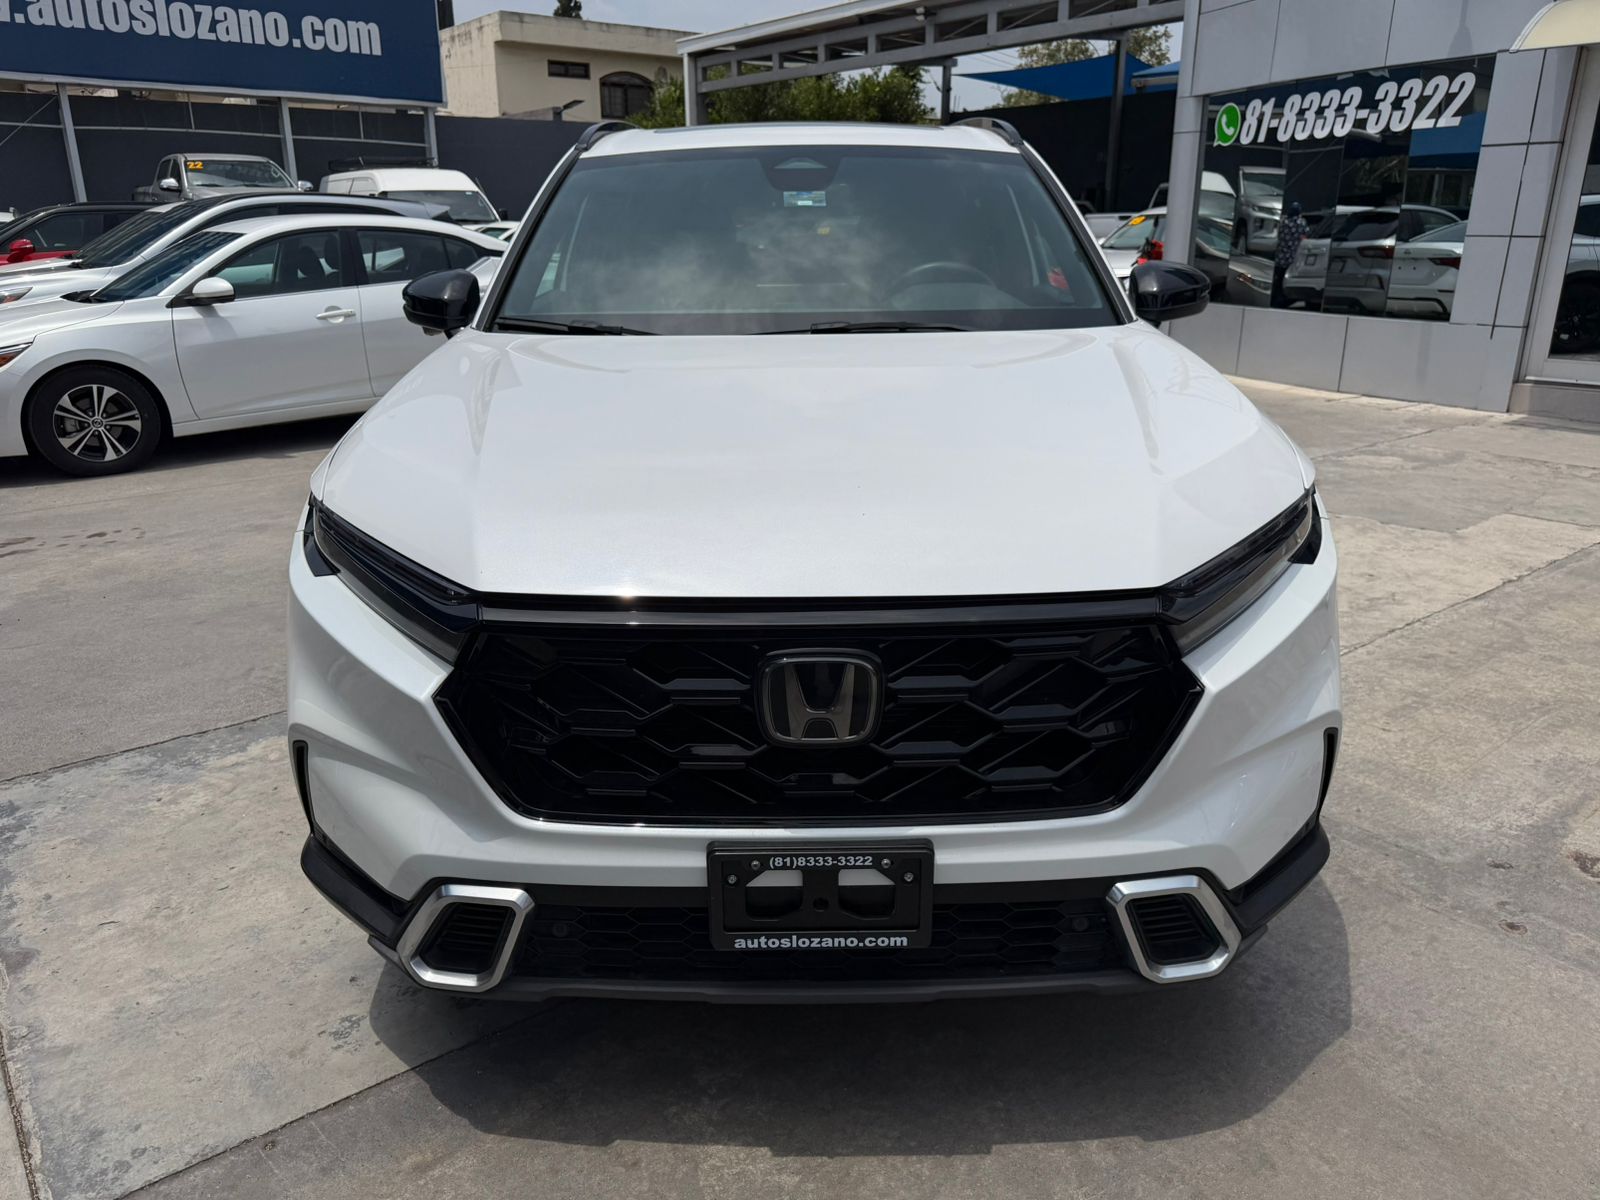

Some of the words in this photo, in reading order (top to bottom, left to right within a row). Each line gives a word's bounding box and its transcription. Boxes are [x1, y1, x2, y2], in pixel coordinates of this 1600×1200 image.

[0, 0, 382, 56] .autoslozano.com
[1239, 72, 1476, 146] 81-8333-3322
[186, 161, 204, 169] 22
[769, 856, 873, 870] (81)8333-3322
[734, 935, 908, 949] autoslozano.com
